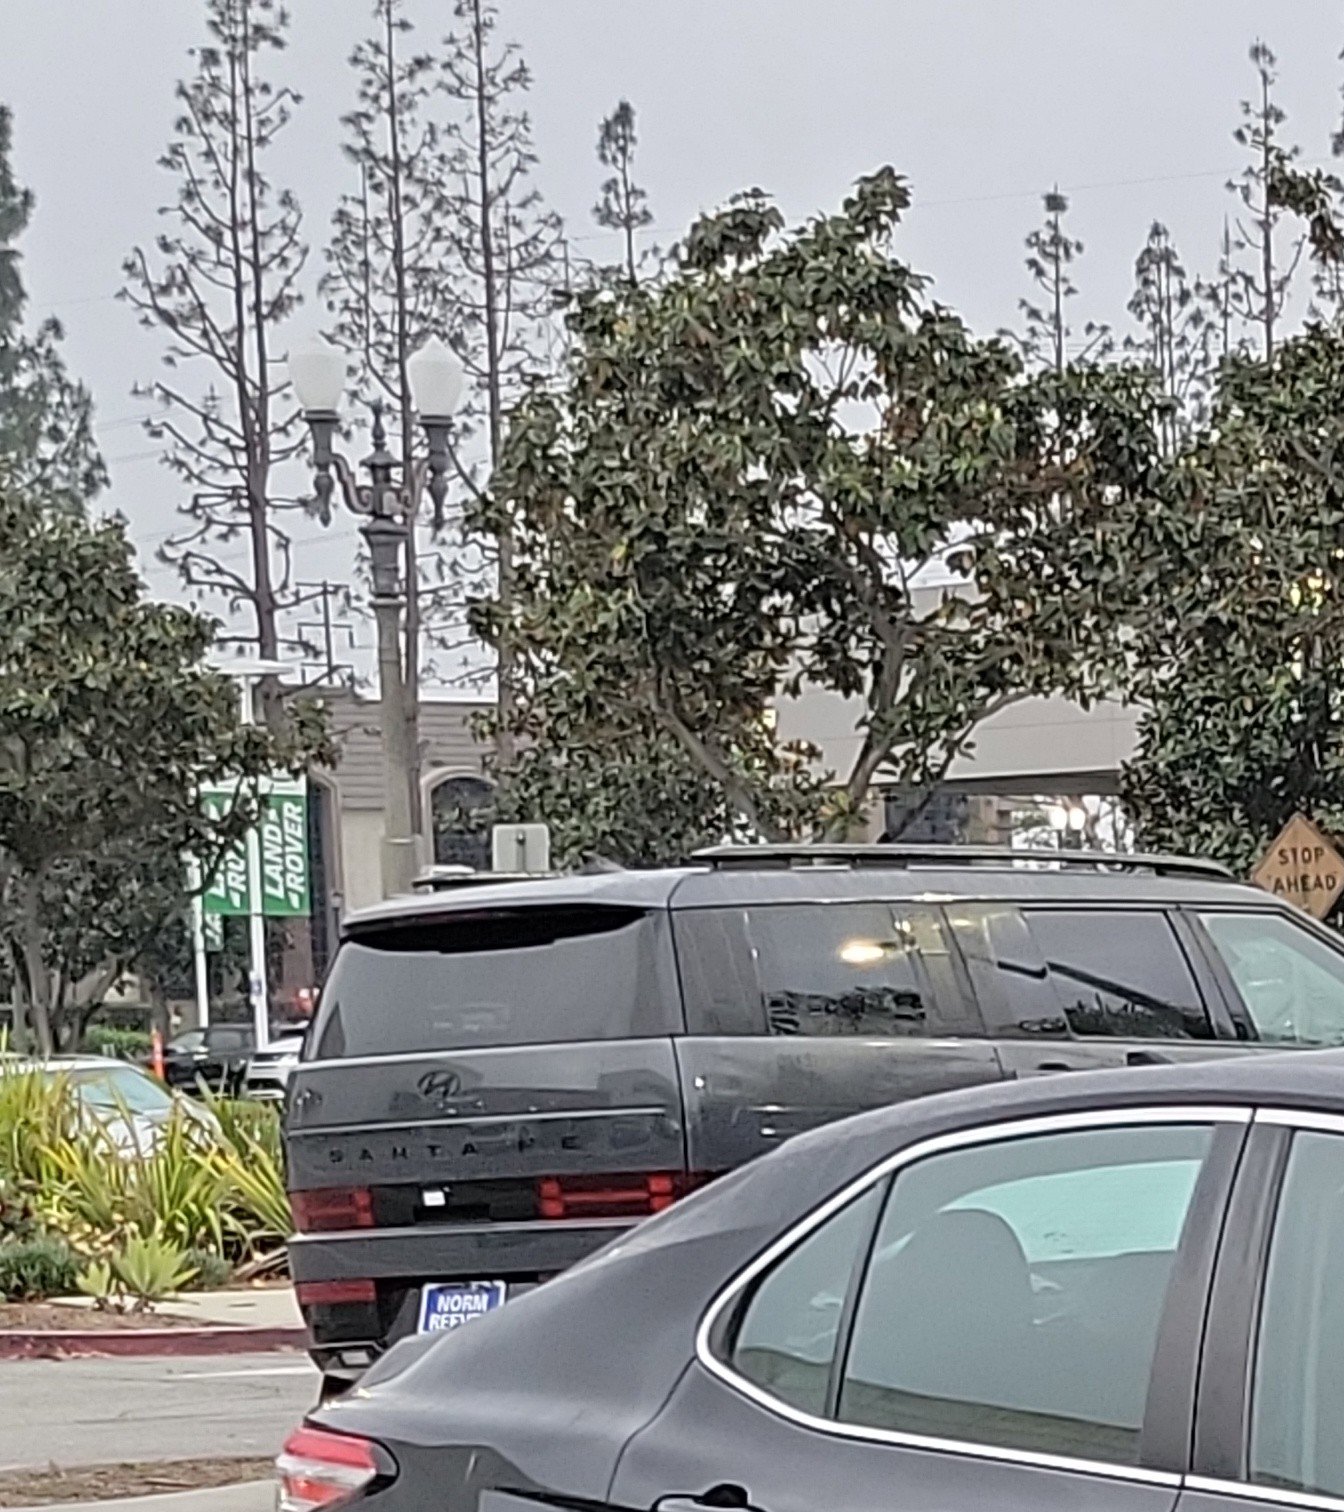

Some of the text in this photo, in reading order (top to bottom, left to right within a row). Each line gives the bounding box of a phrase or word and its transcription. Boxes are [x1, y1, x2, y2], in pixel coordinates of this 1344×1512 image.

[283, 802, 305, 894] ROVER
[1278, 846, 1325, 865] STOP
[262, 822, 285, 899] LAND
[1273, 873, 1336, 895] AHEAD
[329, 1144, 479, 1163] SANTA
[437, 1294, 488, 1312] NORM
